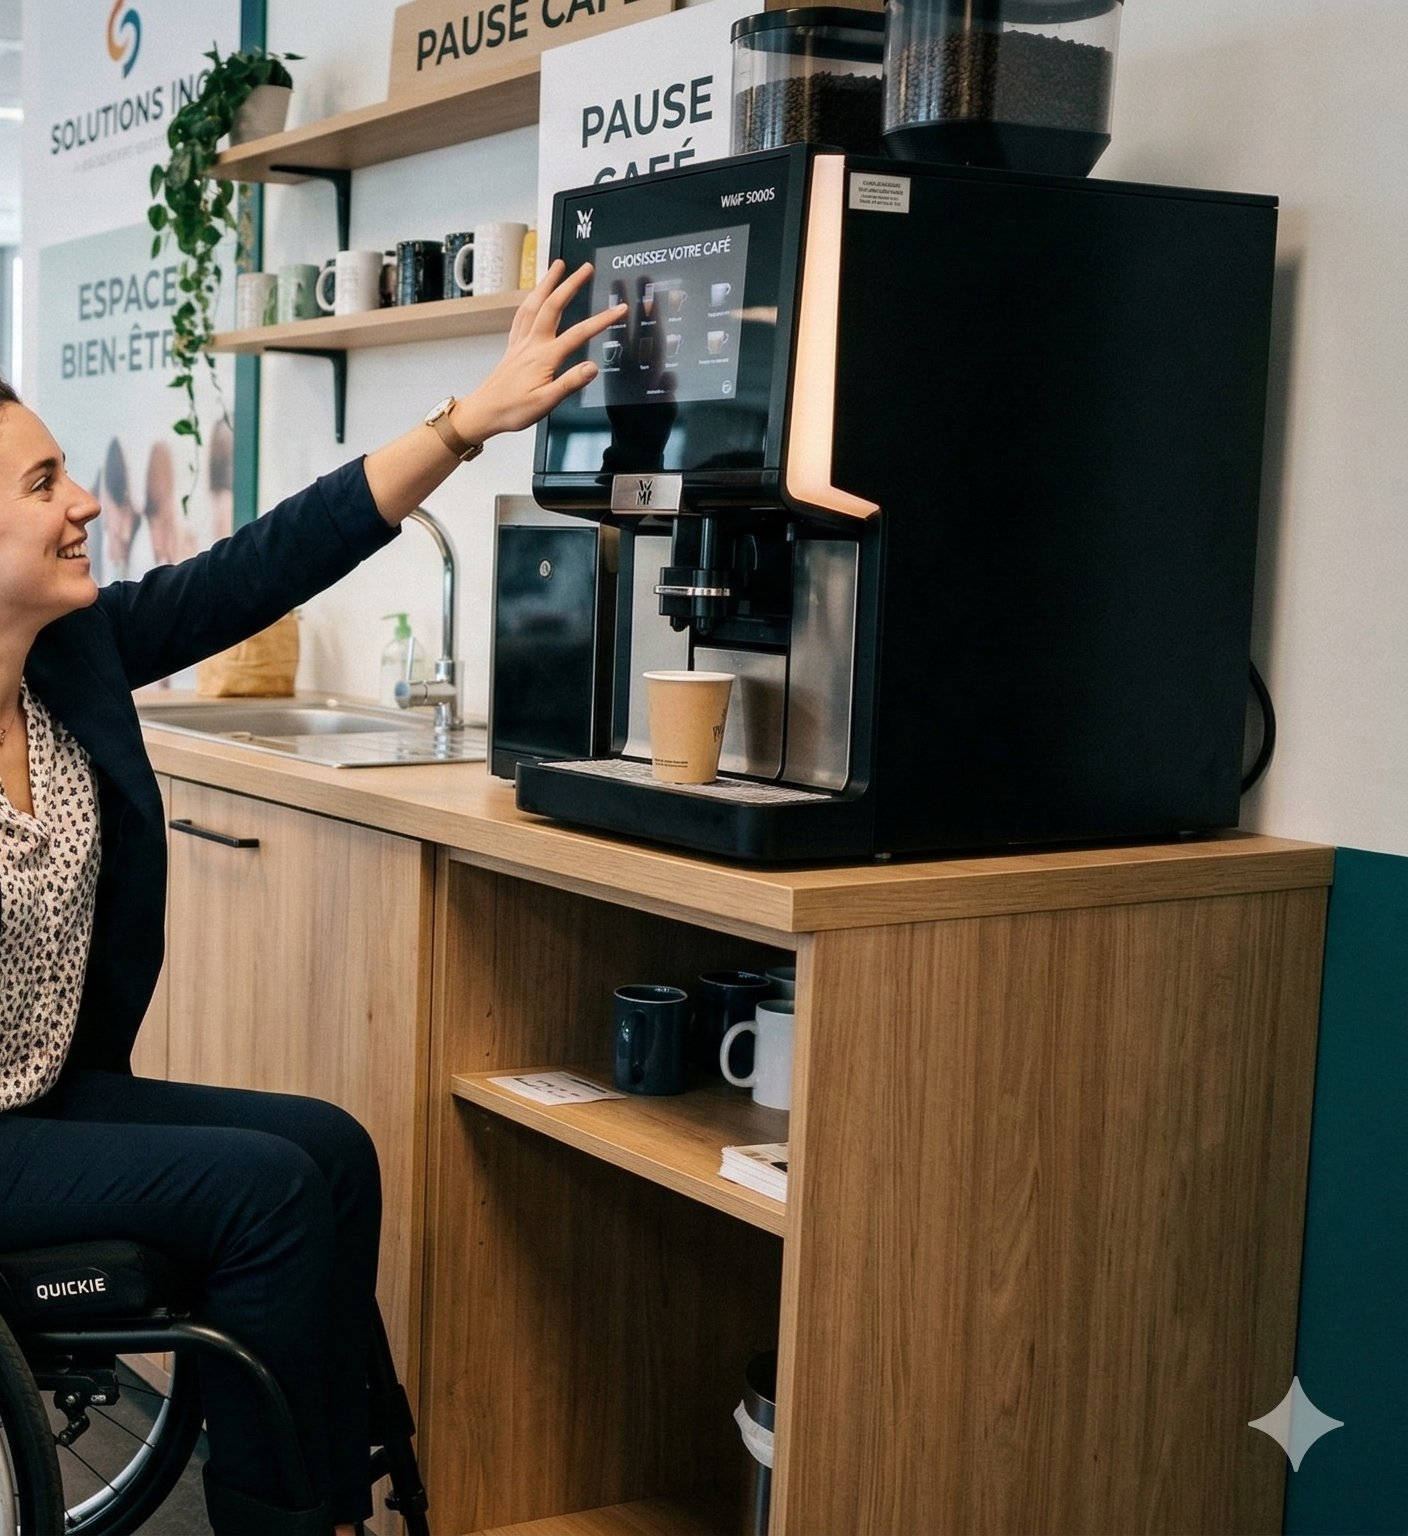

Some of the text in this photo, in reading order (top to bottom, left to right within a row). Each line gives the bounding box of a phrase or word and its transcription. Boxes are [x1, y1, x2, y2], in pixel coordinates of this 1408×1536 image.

[417, 0, 529, 71] PAUSE
[51, 86, 164, 155] SOLUTIONS
[582, 75, 713, 149] PAUSE
[612, 235, 732, 270] CHOISISSEZ VOTRE CAFÉ
[79, 266, 177, 321] ESPACE
[62, 322, 198, 379] BIEN-ÊTR
[36, 1277, 106, 1300] QUICKIE
